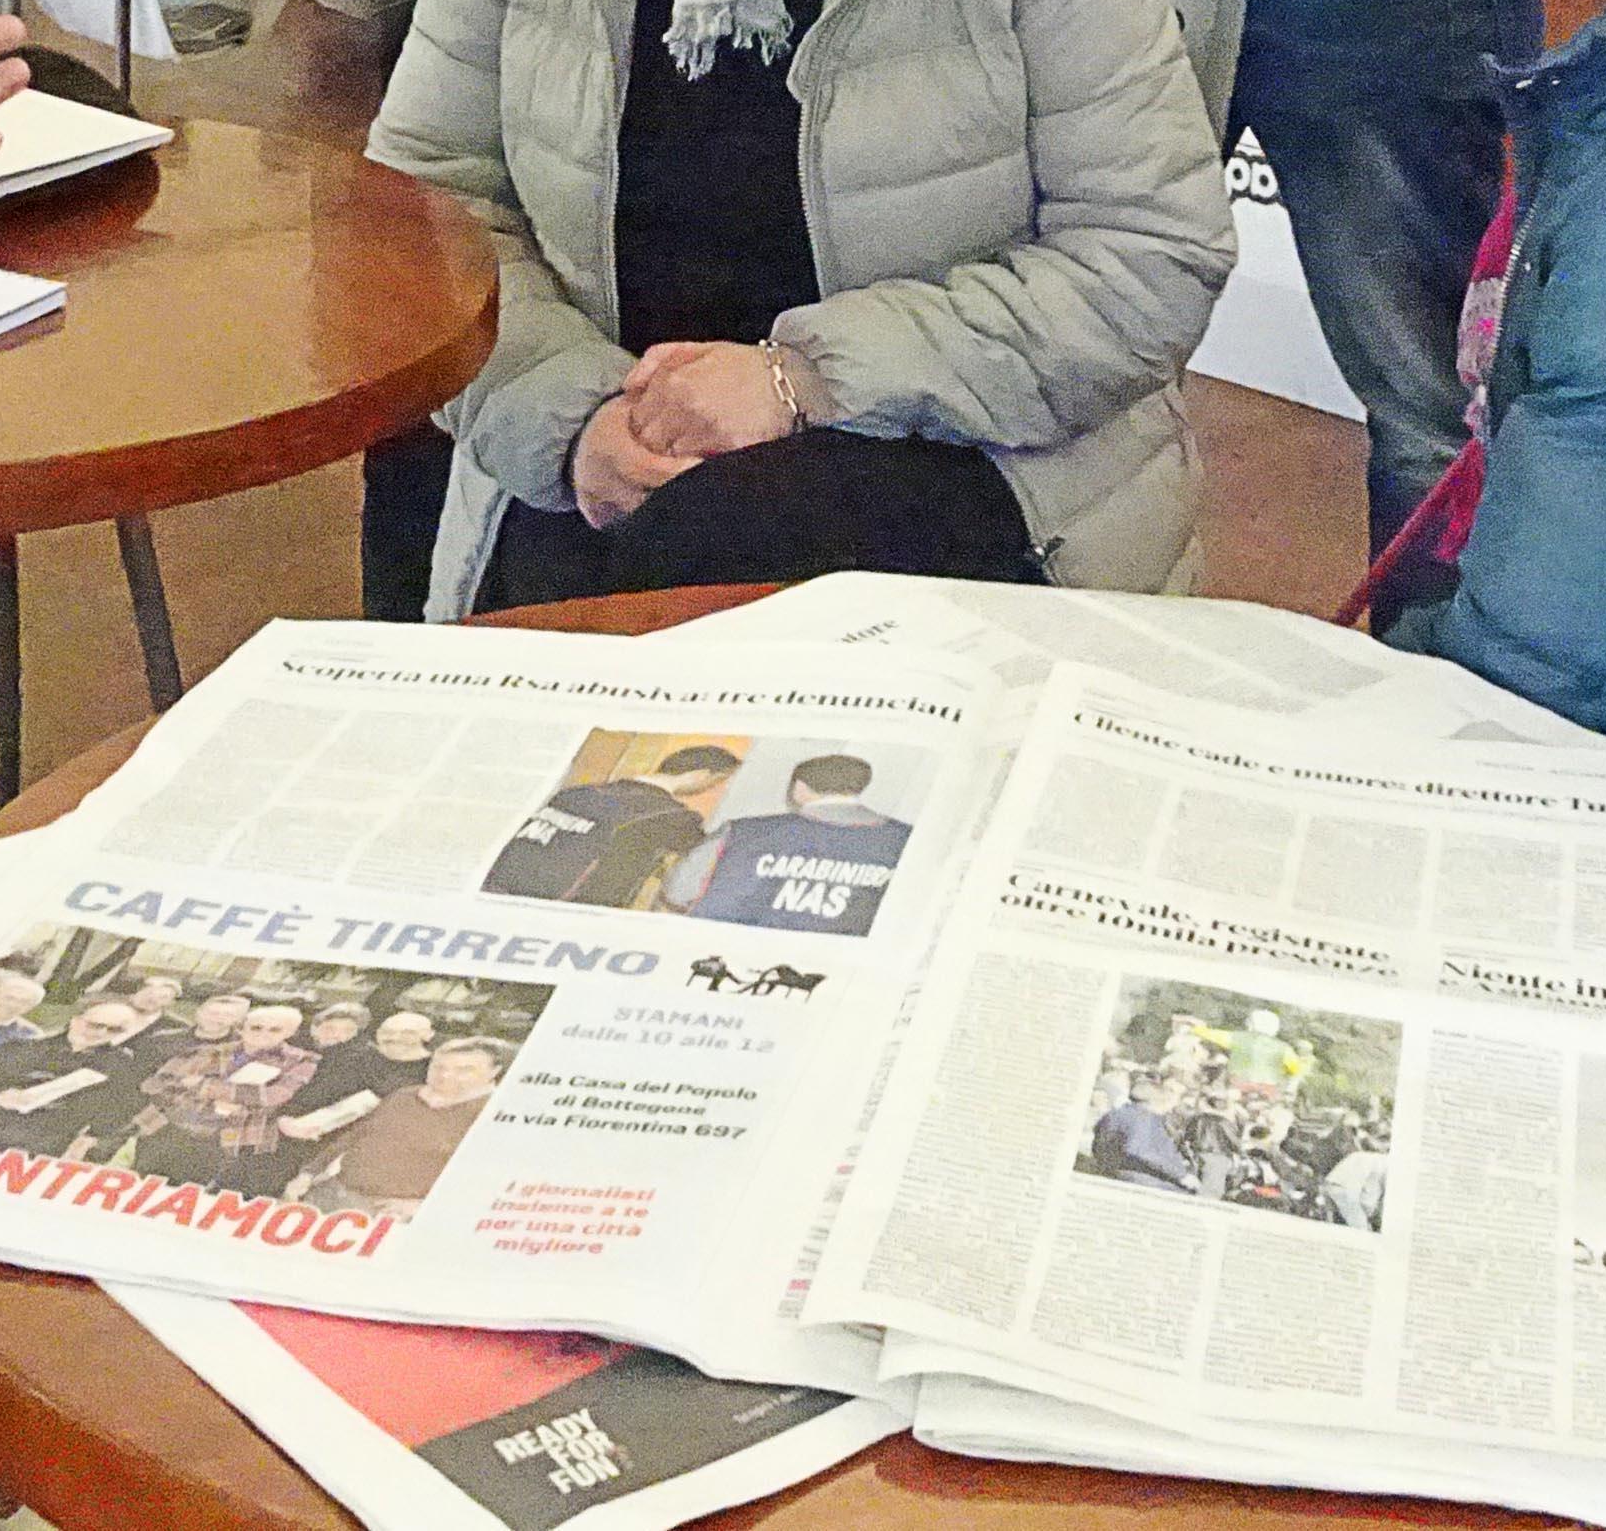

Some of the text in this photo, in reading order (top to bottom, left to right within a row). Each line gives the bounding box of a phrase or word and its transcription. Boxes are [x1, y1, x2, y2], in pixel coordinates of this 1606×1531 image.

[281, 660, 422, 685] Scoperta
[429, 672, 492, 687] una
[499, 674, 561, 692] Rsa
[715, 689, 767, 705] tre
[773, 690, 963, 724] denunciati
[1073, 712, 1181, 749] Cliente
[1187, 746, 1261, 770] cade
[1293, 768, 1406, 791] muore:
[1414, 781, 1559, 809] direttore
[772, 878, 852, 919] NAS
[62, 879, 661, 978] CAFFÈ TIRRENO
[1000, 892, 1399, 976] oltre 10mila presenze
[1211, 919, 1392, 962] registrate
[1441, 960, 1566, 992] Niente
[614, 1006, 745, 1030] STAMANI
[561, 1023, 776, 1054] dalle 10 alle 12
[520, 1070, 759, 1102] alla Casa del Popolo
[554, 1094, 708, 1117] di Bottegone
[493, 1110, 749, 1140] in via Fiorentina 697
[490, 1198, 650, 1218] insieme a te
[520, 1182, 657, 1202] giornalisti
[474, 1218, 521, 1234] per
[525, 1221, 576, 1233] una
[492, 1237, 605, 1256] migliore
[492, 1407, 600, 1465] READY
[545, 1429, 617, 1470] FOR
[548, 1456, 622, 1495] FUN
